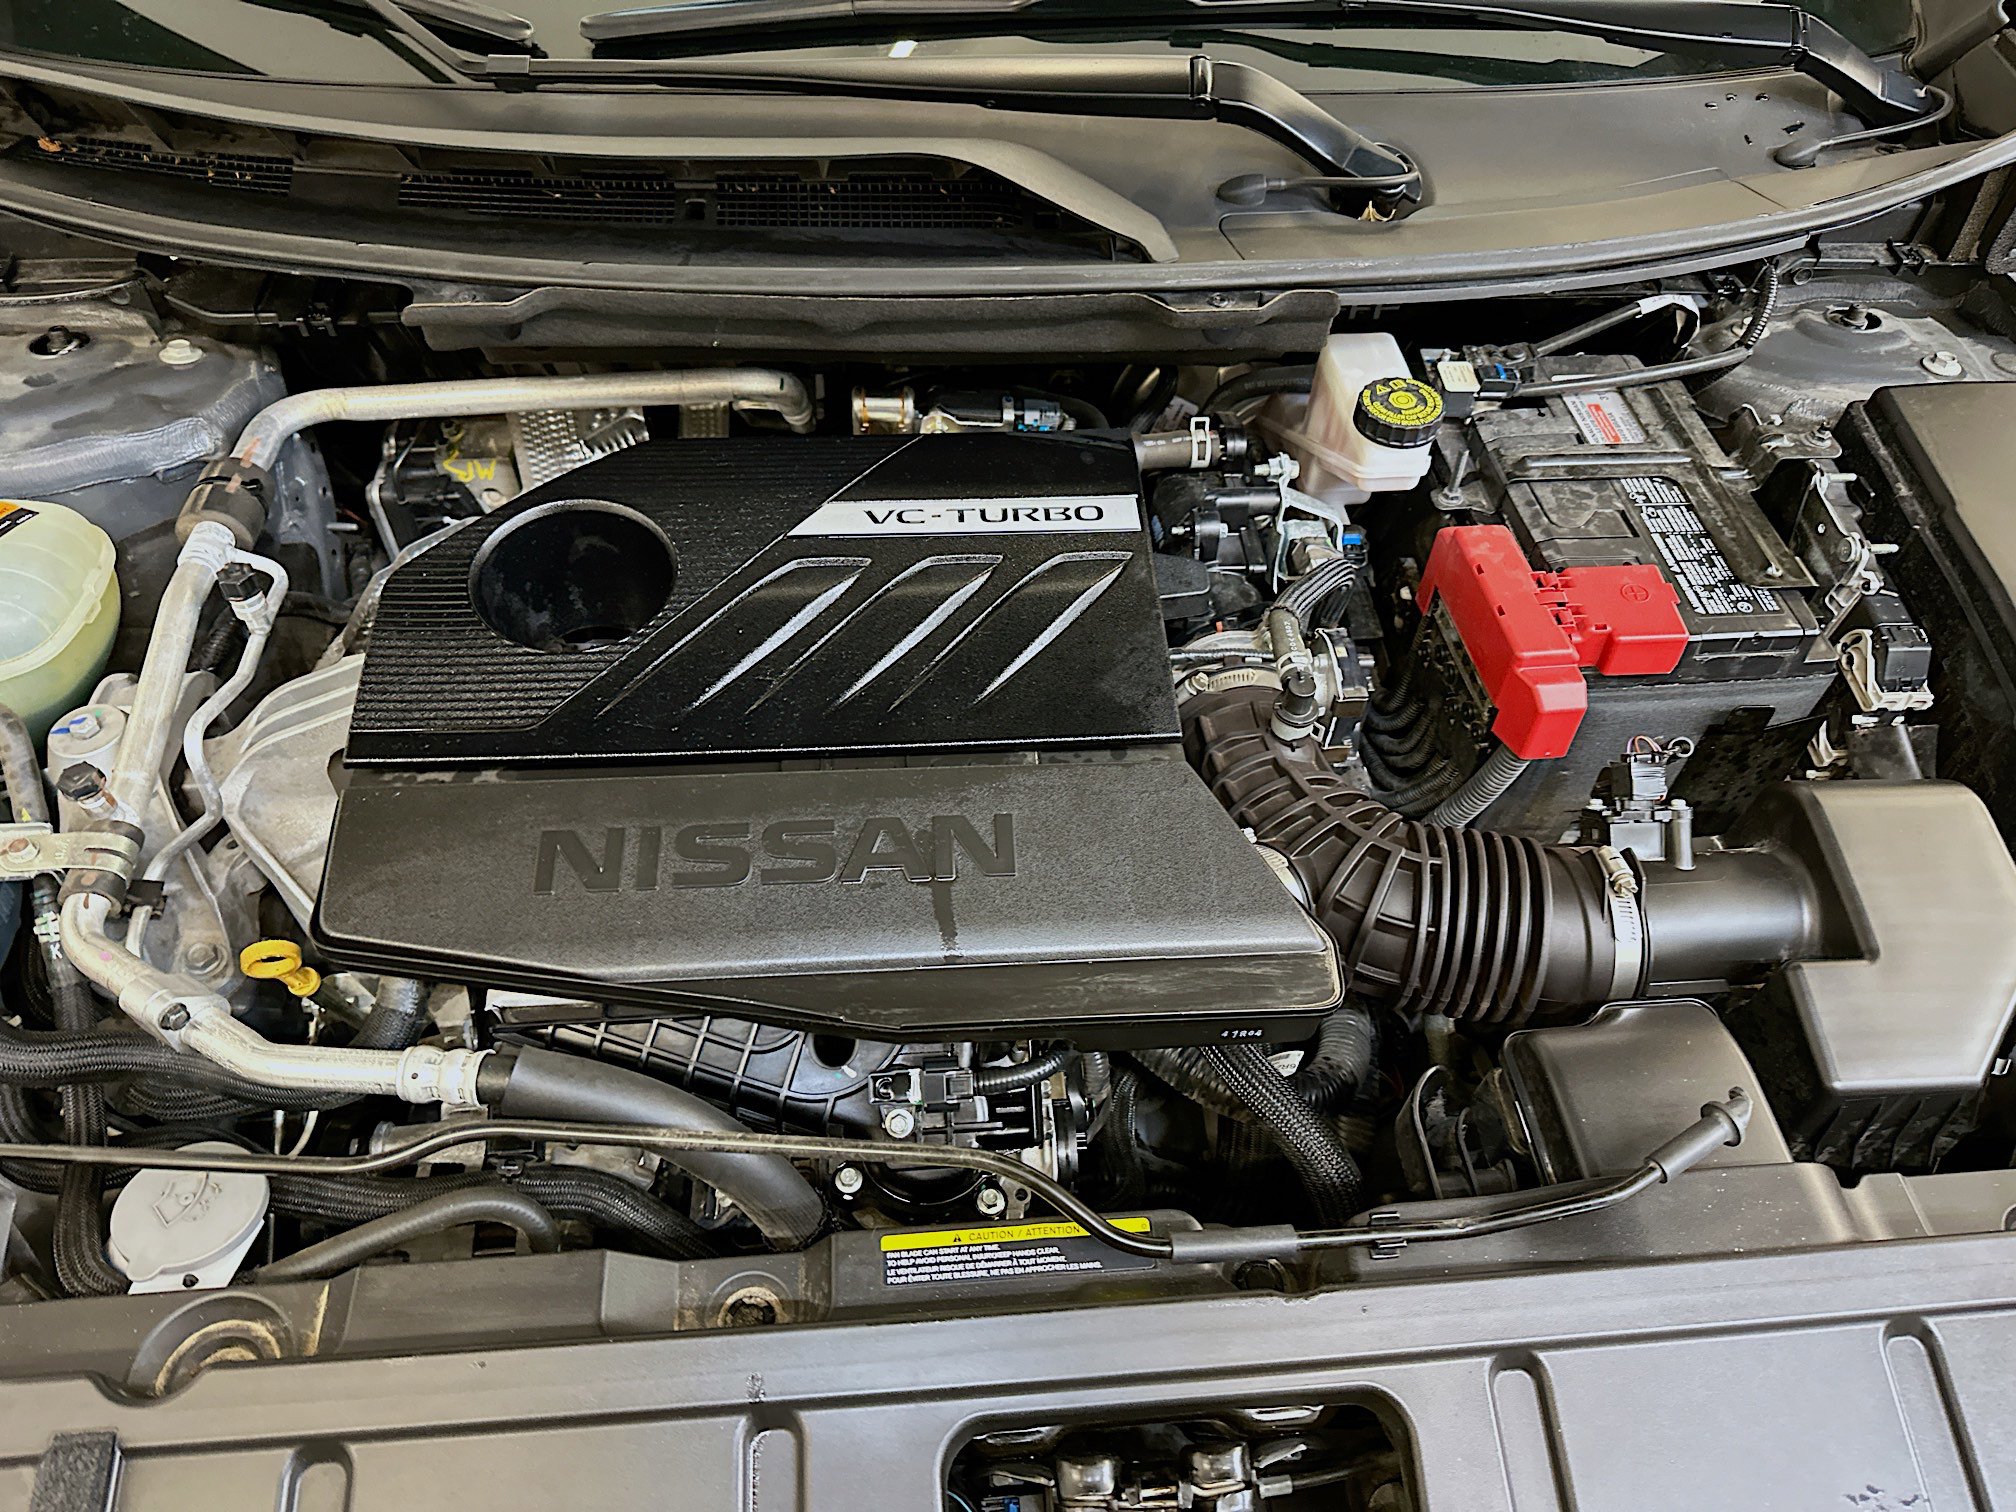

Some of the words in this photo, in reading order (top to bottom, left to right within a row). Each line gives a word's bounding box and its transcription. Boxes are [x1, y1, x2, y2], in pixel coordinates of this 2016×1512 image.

[863, 505, 1104, 525] VC-TURBO
[533, 812, 1017, 896] NISSAN
[969, 1230, 1014, 1241] CAUTION
[1025, 1225, 1081, 1237] ATTENTION
[886, 1251, 900, 1259] FAN
[900, 1249, 923, 1258] BLADE
[923, 1248, 938, 1256] CAN
[938, 1246, 960, 1255] START
[960, 1245, 969, 1253] AT
[886, 1259, 897, 1267] TO
[897, 1258, 916, 1266] HELP
[915, 1256, 936, 1265] AVOID
[936, 1254, 972, 1263] PERSONAL
[1012, 1249, 1036, 1257] HANDS
[886, 1268, 897, 1276] LE
[896, 1265, 940, 1275] VENTILATEUR
[965, 1262, 975, 1270] DE
[1018, 1257, 1036, 1266] TOUT
[886, 1276, 908, 1284] POUR
[930, 1271, 953, 1280] TOUTE
[989, 1268, 1000, 1276] NE
[1000, 1267, 1014, 1275] PAS
[1014, 1266, 1025, 1274] EN
[1024, 1263, 1066, 1273] APPROCHER
[1065, 1262, 1080, 1271] LES
